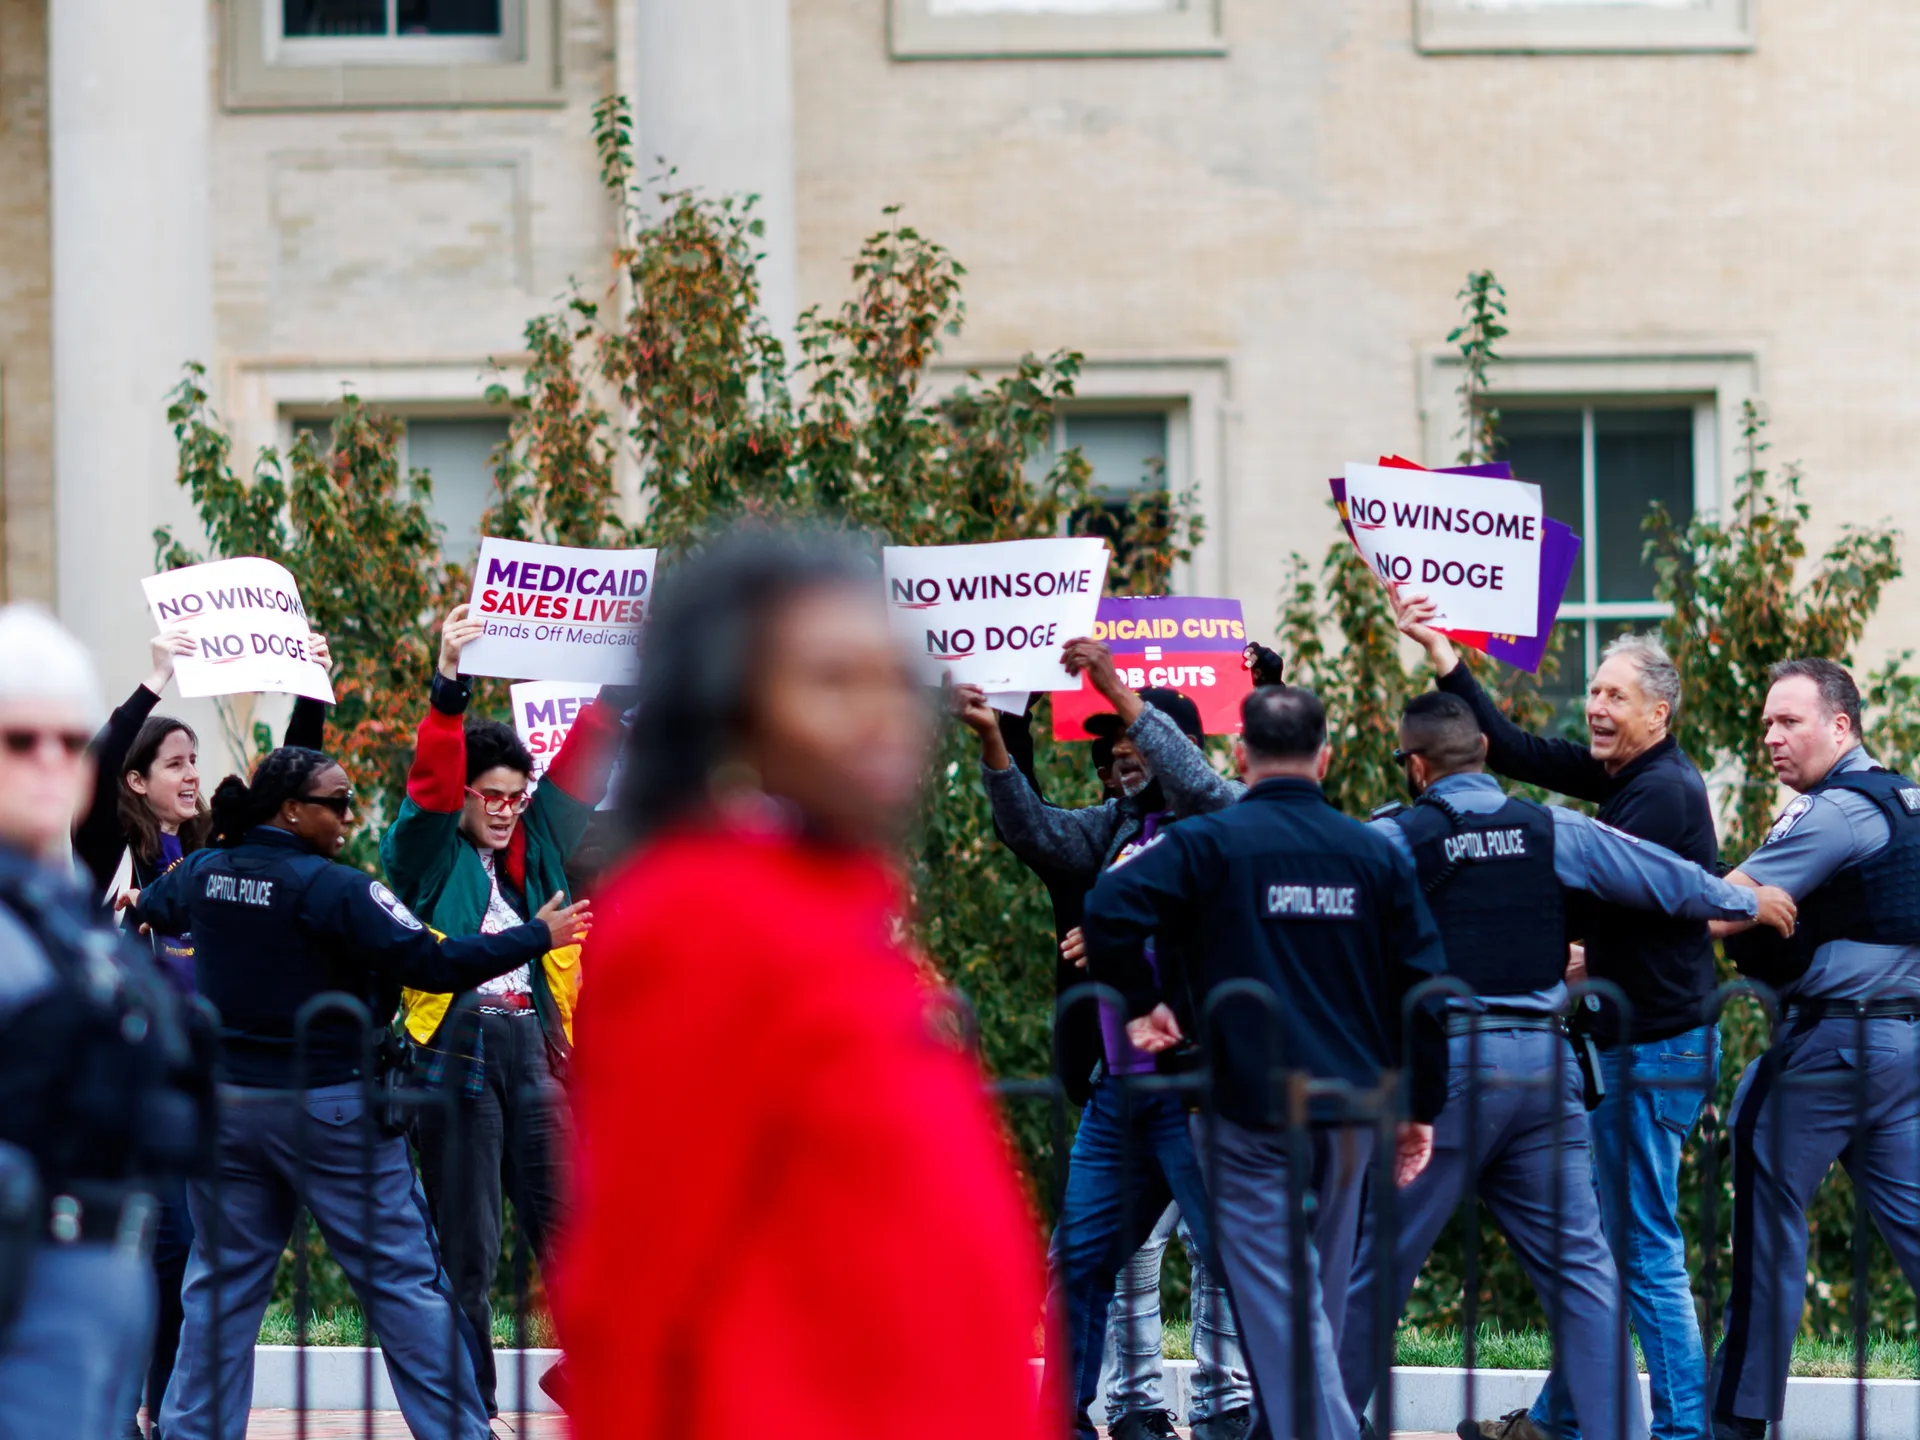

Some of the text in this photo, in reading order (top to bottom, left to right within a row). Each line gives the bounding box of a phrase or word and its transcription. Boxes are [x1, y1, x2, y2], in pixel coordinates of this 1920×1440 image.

[1351, 495, 1386, 524] NO
[1393, 502, 1536, 541] WINSOME
[486, 558, 648, 597] MEDICAID
[891, 569, 1091, 602] NO WINSOME
[1375, 552, 1504, 590] NO DOGE
[157, 594, 204, 619] NO
[480, 589, 644, 623] SAVES LIVES
[535, 625, 564, 642] Off
[926, 622, 1057, 653] NO DOGE
[1092, 618, 1245, 641] DICAID CUTS
[200, 633, 307, 662] NO DOGE
[1148, 666, 1216, 687] CUTS
[1444, 829, 1525, 862] CAPITOL POLICE
[206, 874, 273, 906] CAPITOL POLICE
[1267, 885, 1355, 915] CAPITOL POLICE
